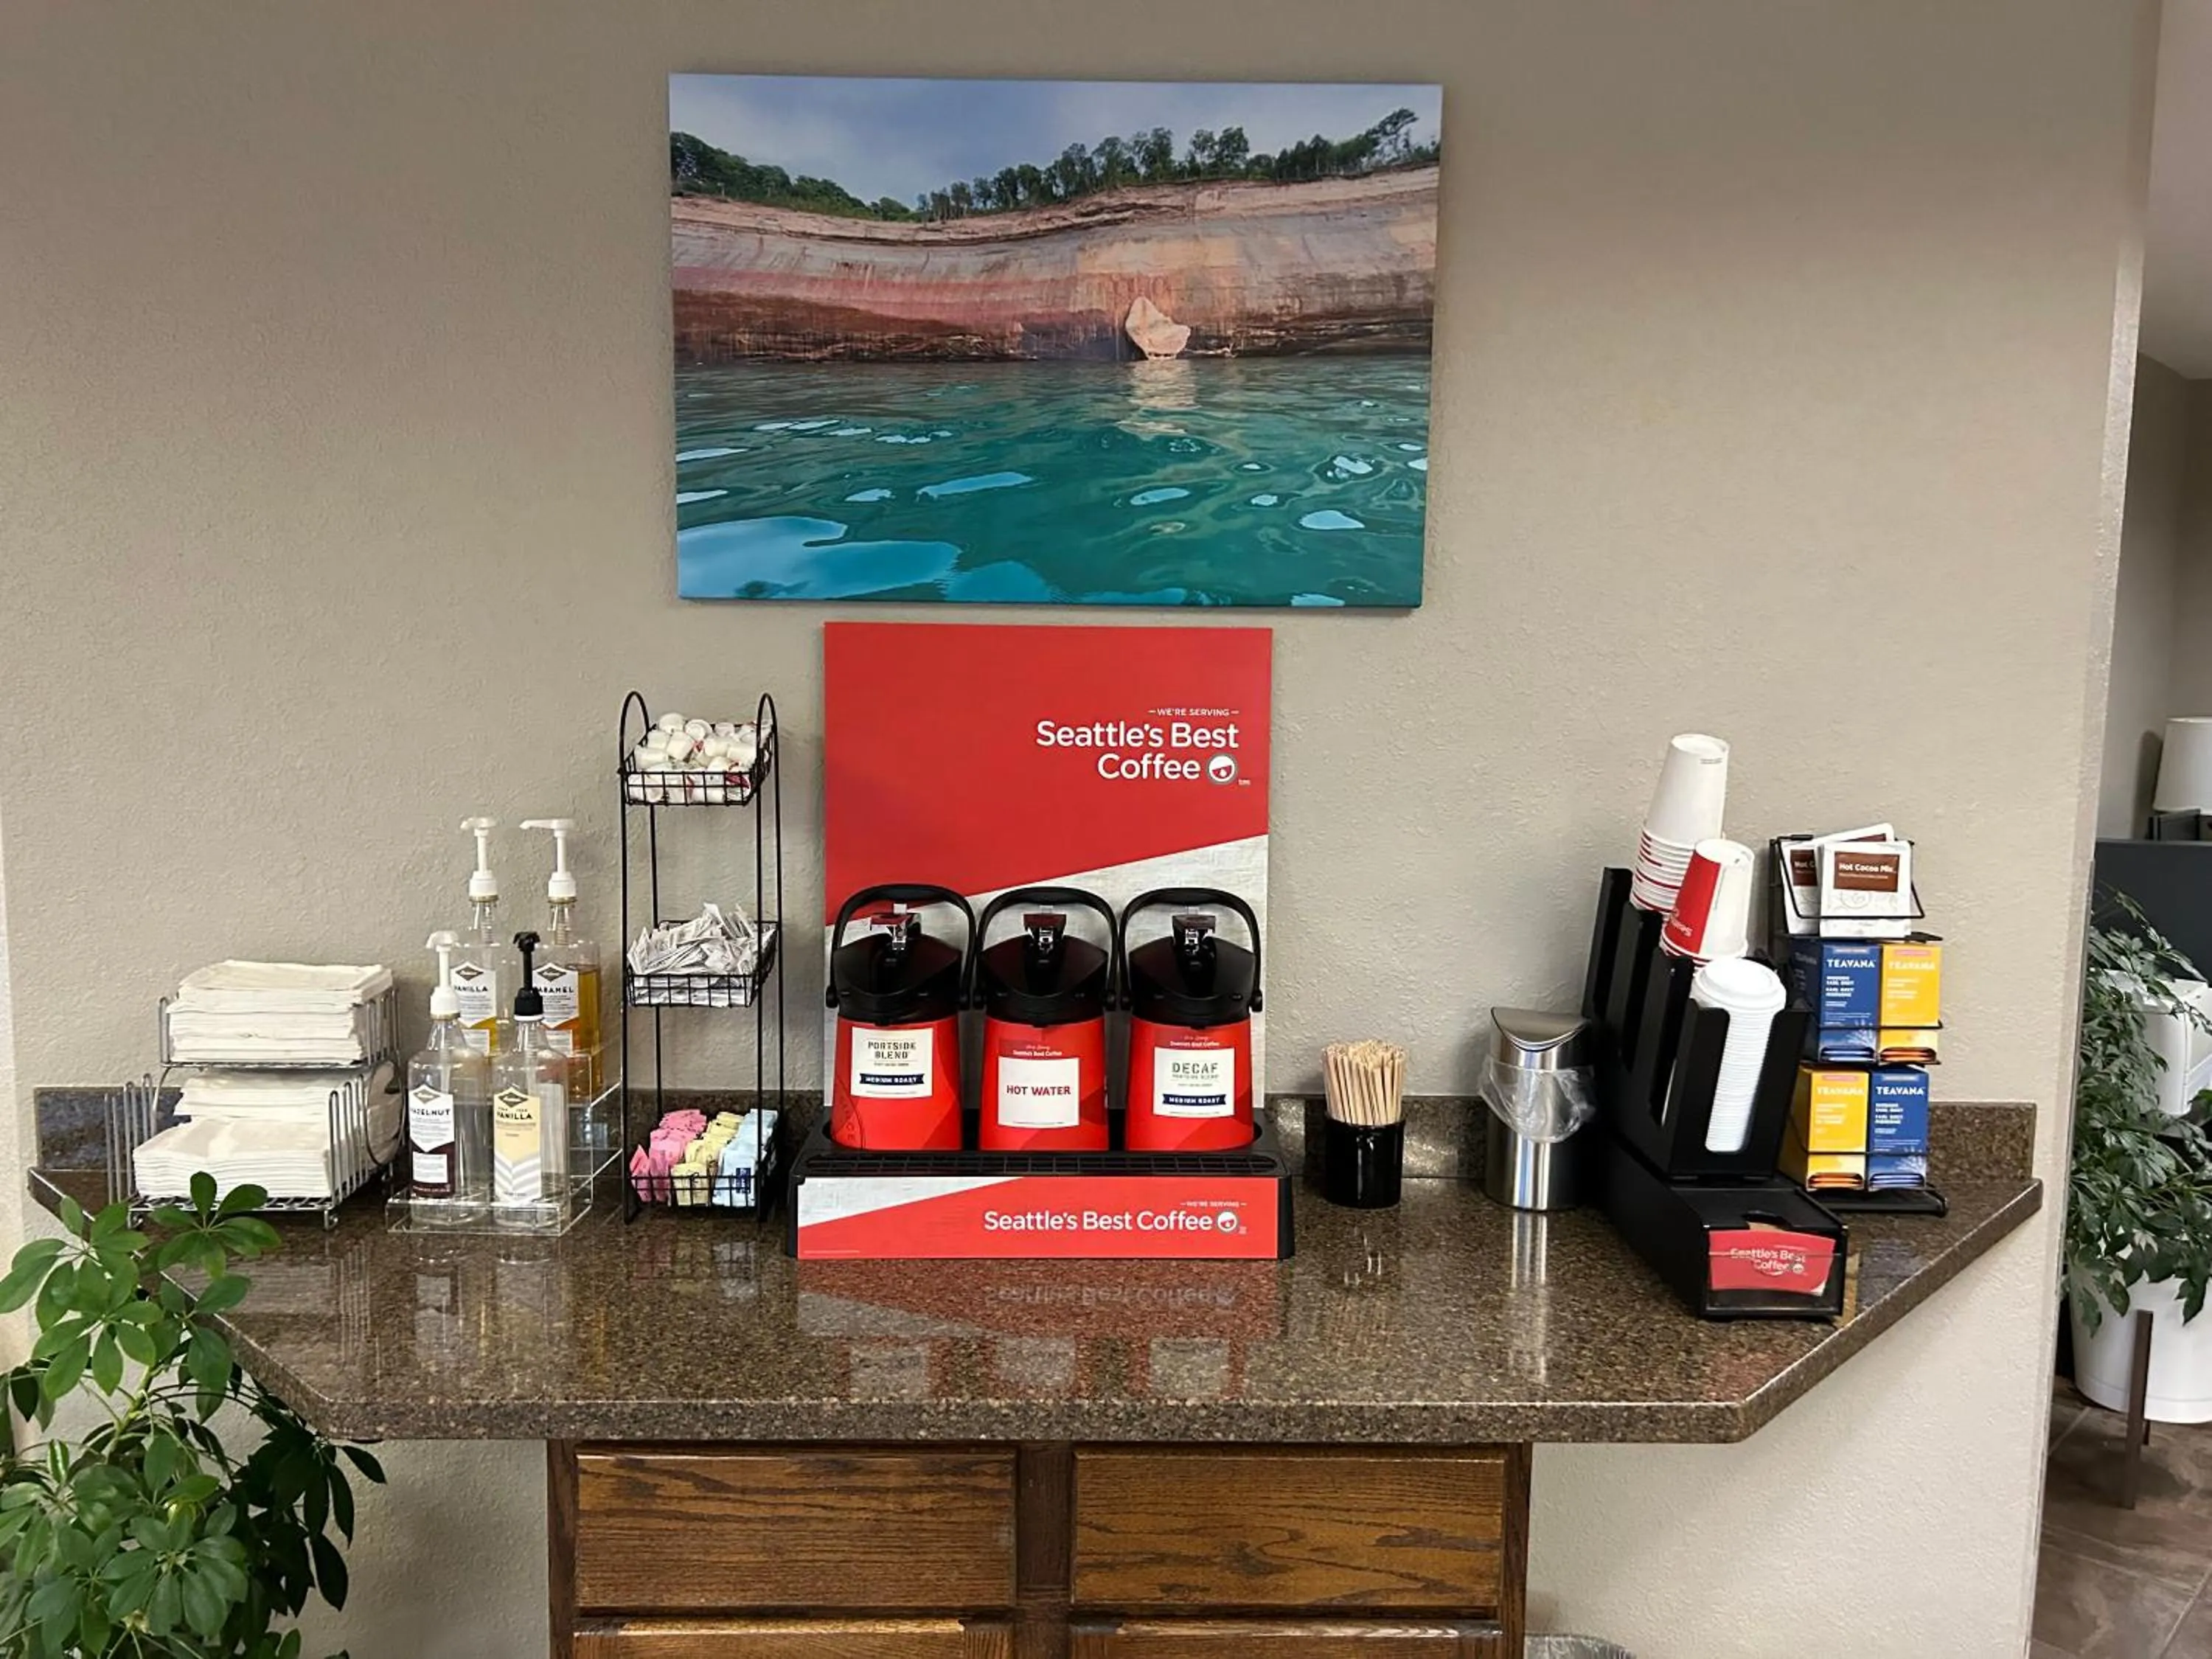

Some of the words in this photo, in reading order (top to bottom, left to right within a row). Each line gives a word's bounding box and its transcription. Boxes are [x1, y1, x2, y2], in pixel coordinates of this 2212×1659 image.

[1157, 708, 1186, 716] WE'RE
[1189, 708, 1230, 716] SERVING
[1036, 720, 1164, 748] Seattle's
[1171, 722, 1239, 748] Best
[1097, 753, 1201, 779] Coffee
[1838, 863, 1853, 871] Hot
[1854, 863, 1879, 872] Cocoa
[1826, 959, 1876, 968] TEAVANA
[868, 1041, 917, 1051] PORTSIDE
[874, 1051, 908, 1060] BLEND
[1172, 1062, 1219, 1074] DECAF
[1006, 1085, 1029, 1095] HOT
[1031, 1085, 1071, 1096] WATER
[1875, 1086, 1924, 1096] TEAVANA
[496, 1111, 533, 1120] VANILLA
[984, 1211, 1077, 1231] Seattle's
[1082, 1211, 1133, 1231] Best
[1137, 1211, 1213, 1231] Coffee
